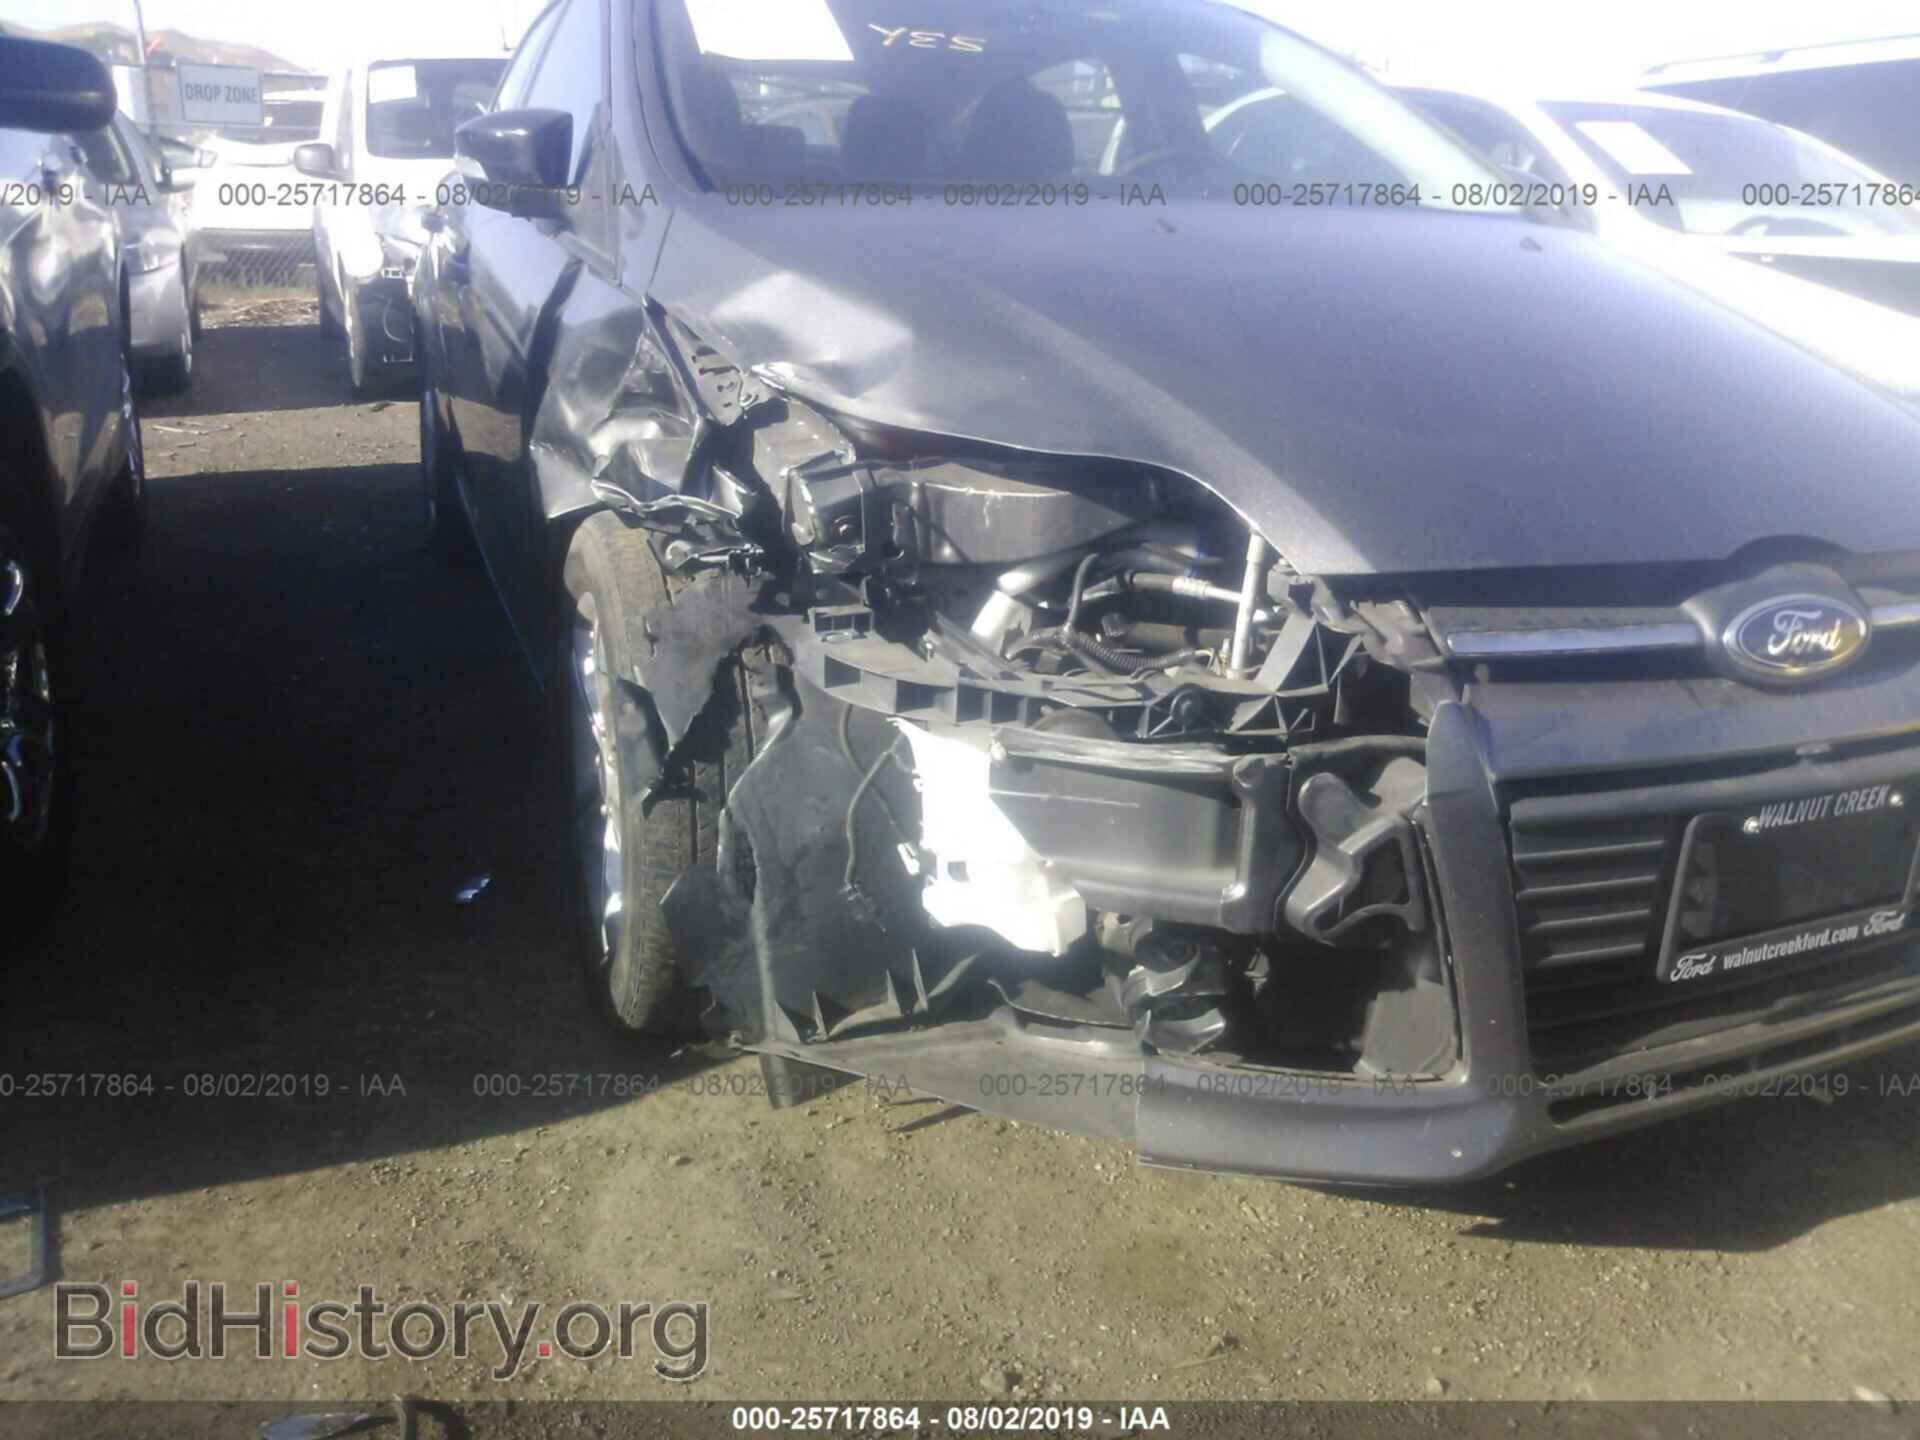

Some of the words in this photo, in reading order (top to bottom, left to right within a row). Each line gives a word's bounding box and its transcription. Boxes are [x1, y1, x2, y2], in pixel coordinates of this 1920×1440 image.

[184, 82, 221, 102] DROP
[223, 85, 258, 105] ZONE
[1768, 609, 1842, 656] Ford
[1758, 794, 1834, 829] WALNUT
[1833, 783, 1891, 817] CREEK
[1669, 952, 1717, 982] Ford
[1723, 925, 1859, 970] walnutcreekford.com
[1863, 910, 1906, 937] Ford
